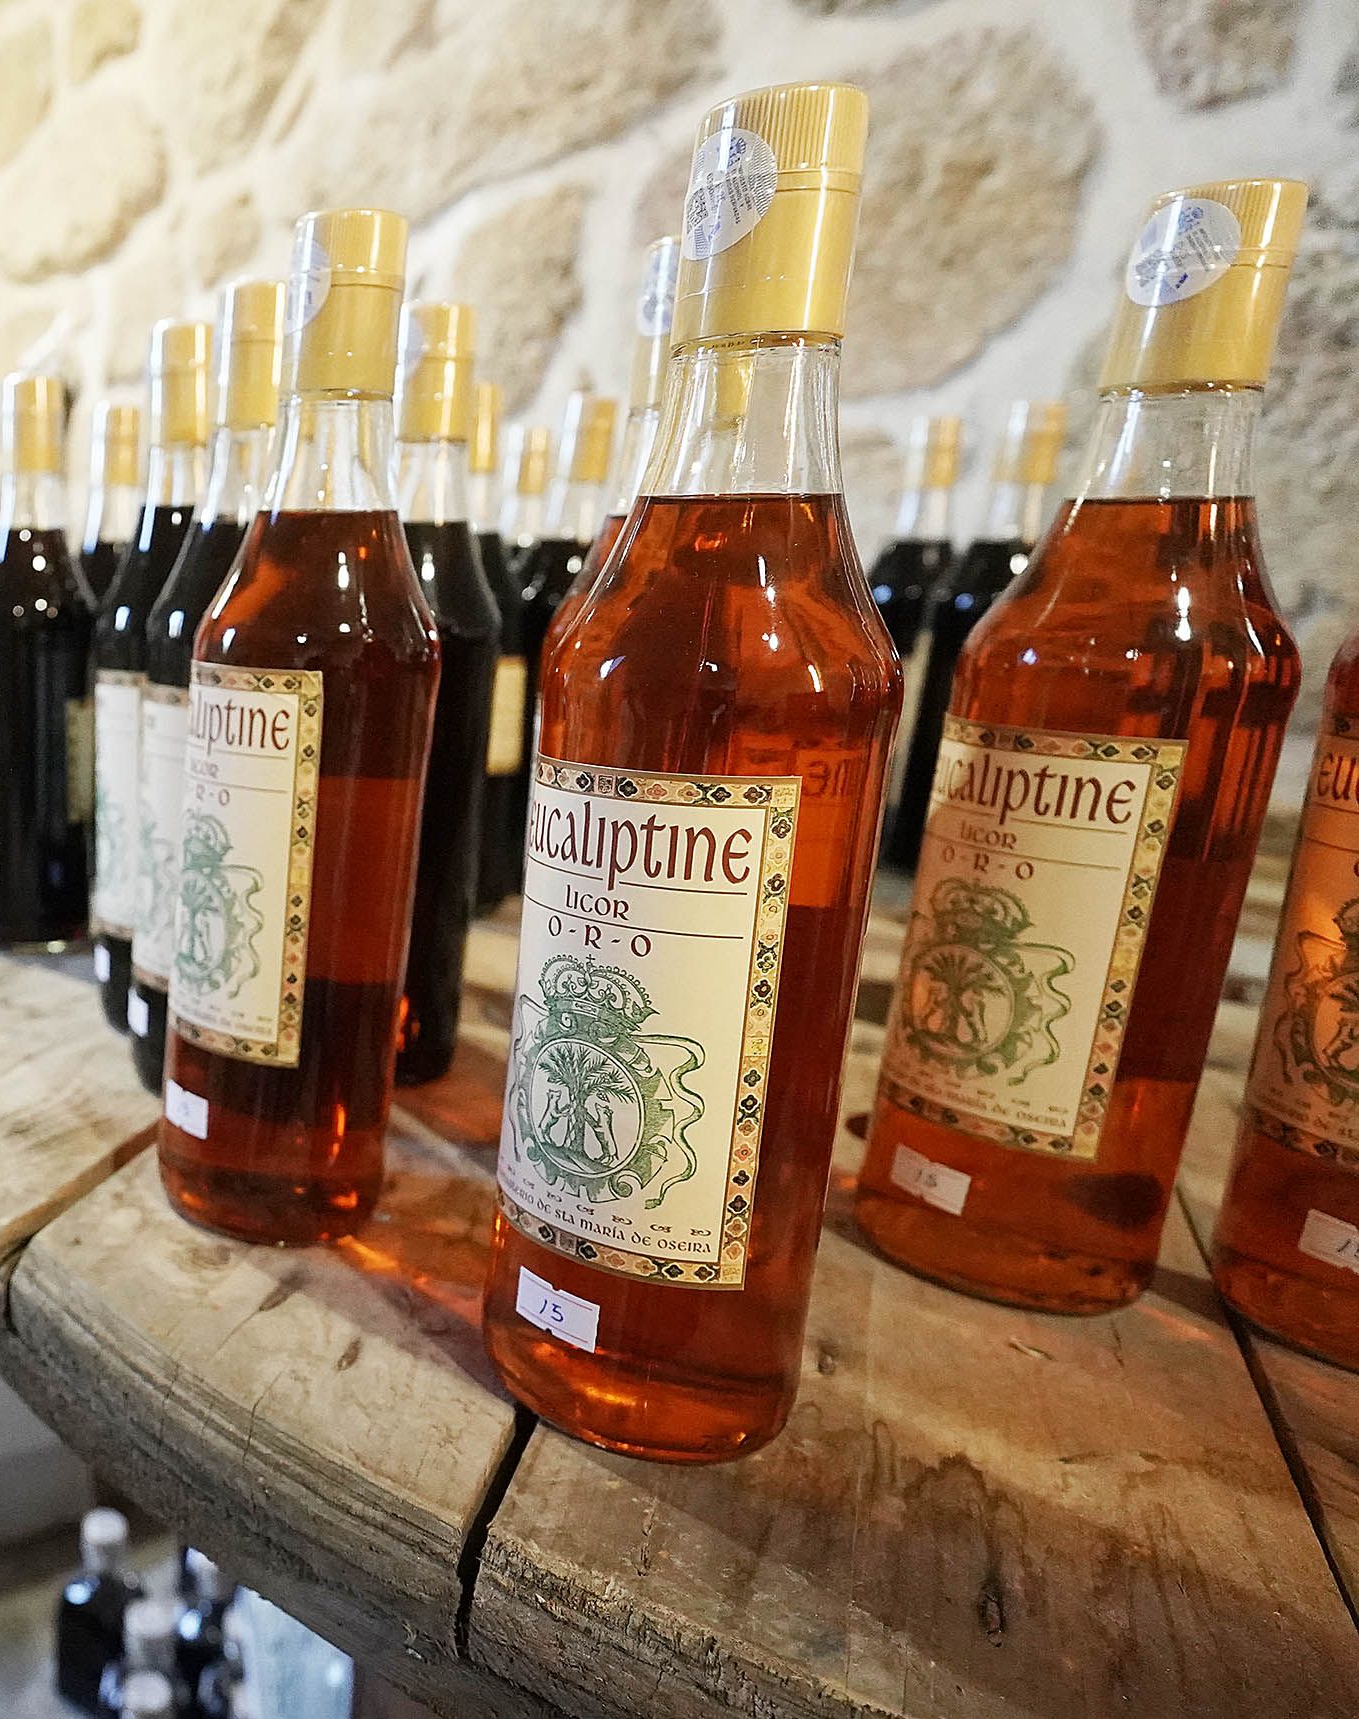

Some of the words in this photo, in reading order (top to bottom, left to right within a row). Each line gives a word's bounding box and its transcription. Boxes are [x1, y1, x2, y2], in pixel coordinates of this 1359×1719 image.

[960, 821, 1017, 849] LICOR
[566, 884, 630, 921] LICOR
[657, 1239, 712, 1253] OSEIRA
[539, 1299, 564, 1322] 15
